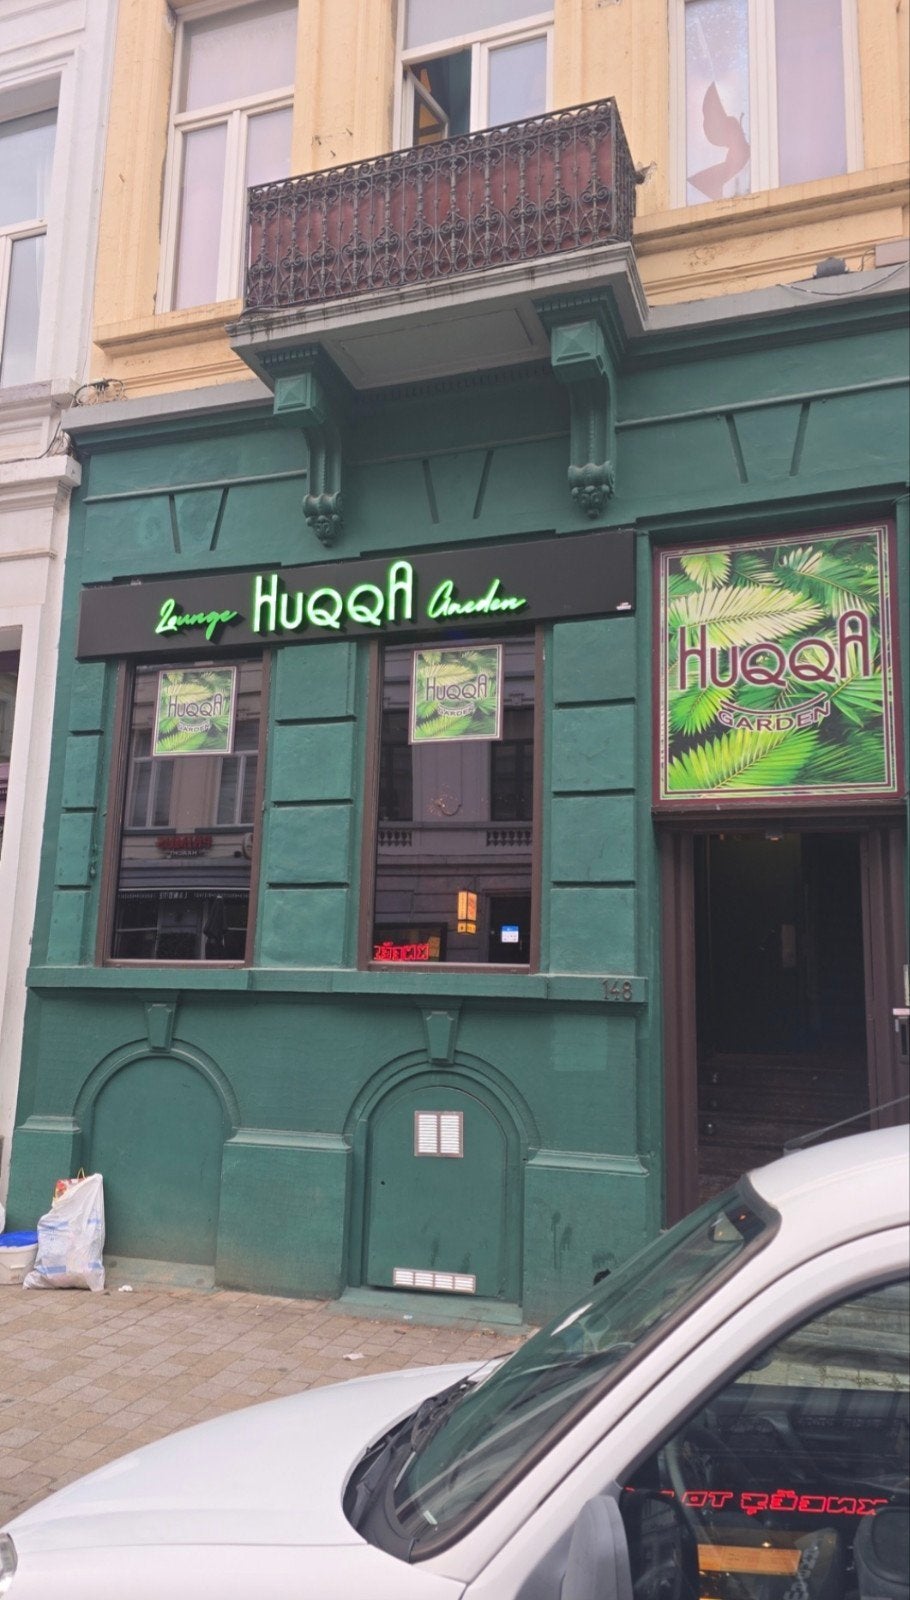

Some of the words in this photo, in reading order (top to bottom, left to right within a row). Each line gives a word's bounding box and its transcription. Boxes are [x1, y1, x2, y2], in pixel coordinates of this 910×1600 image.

[154, 598, 238, 641] Lounge
[252, 560, 414, 633] HUQQA
[428, 579, 527, 619] Garden
[678, 610, 870, 691] HUQQA
[425, 674, 488, 702] HUQQA
[167, 693, 223, 718] HUQQA
[717, 701, 831, 732] GARDEN
[602, 980, 632, 1001] 148
